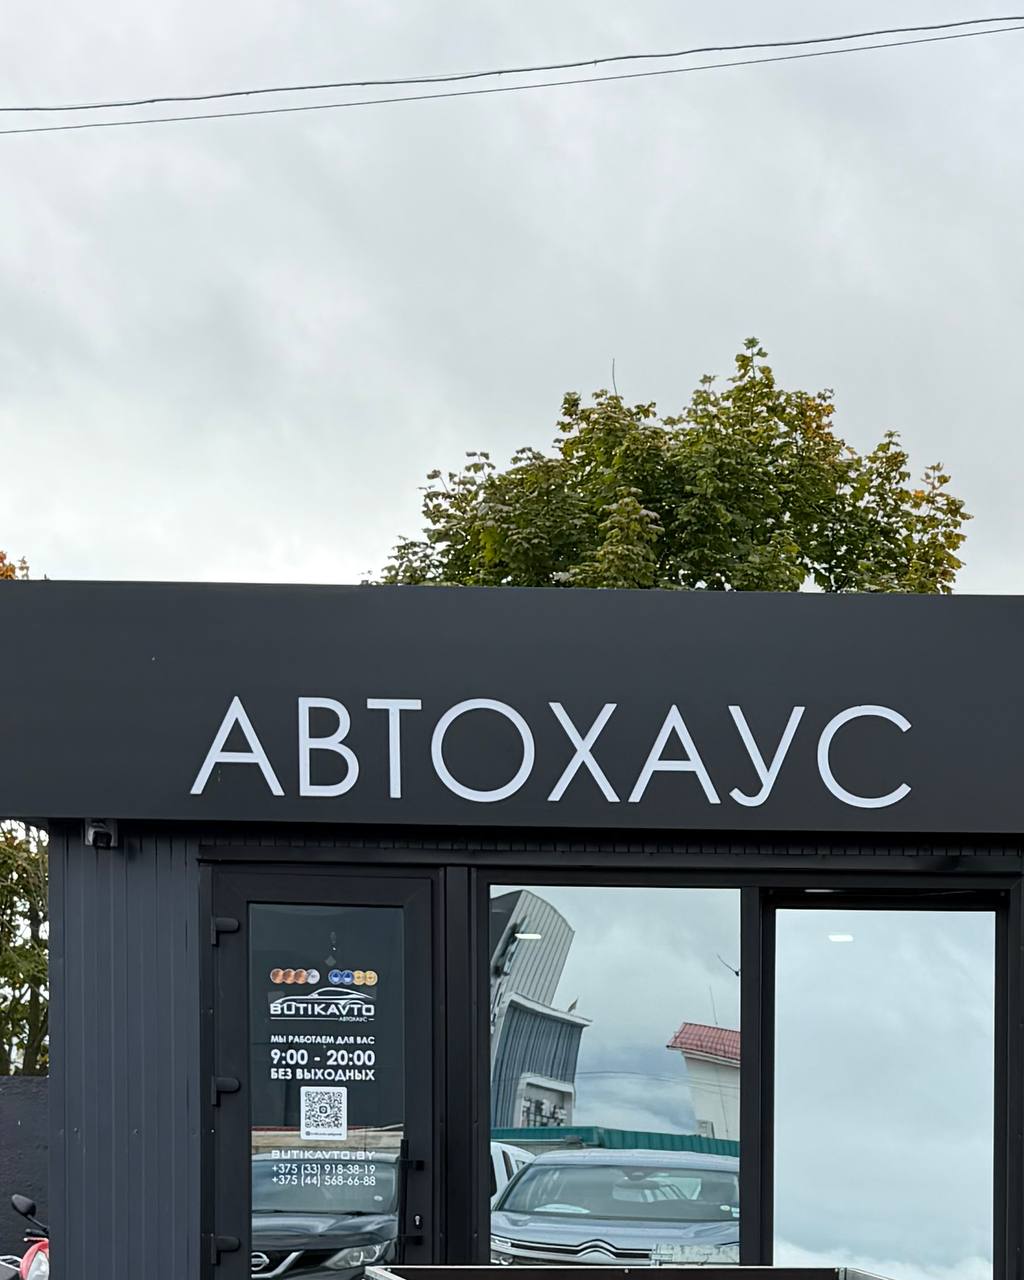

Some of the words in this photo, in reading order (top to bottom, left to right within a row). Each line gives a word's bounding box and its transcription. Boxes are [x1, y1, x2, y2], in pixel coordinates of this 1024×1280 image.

[189, 695, 913, 809] АВТОХАУС
[269, 1002, 375, 1016] BUTIKAVTO
[270, 1035, 286, 1043] МЫ
[288, 1035, 335, 1044] РАБОТАЕМ
[336, 1036, 354, 1045] ДЛЯ
[356, 1036, 375, 1045] ВАС
[270, 1049, 308, 1065] 9:00
[326, 1050, 375, 1066] 20:00
[270, 1068, 292, 1080] БЕЗ
[296, 1068, 375, 1081] ВЫХОДНЫХ
[271, 1150, 376, 1160] BUTIKAVTO.BY
[271, 1164, 298, 1174] +375
[301, 1164, 321, 1176] (33)
[324, 1164, 376, 1175] 918-38-19
[271, 1175, 298, 1185] +375
[301, 1175, 321, 1187] (44)
[324, 1175, 376, 1186] 568-66-88
